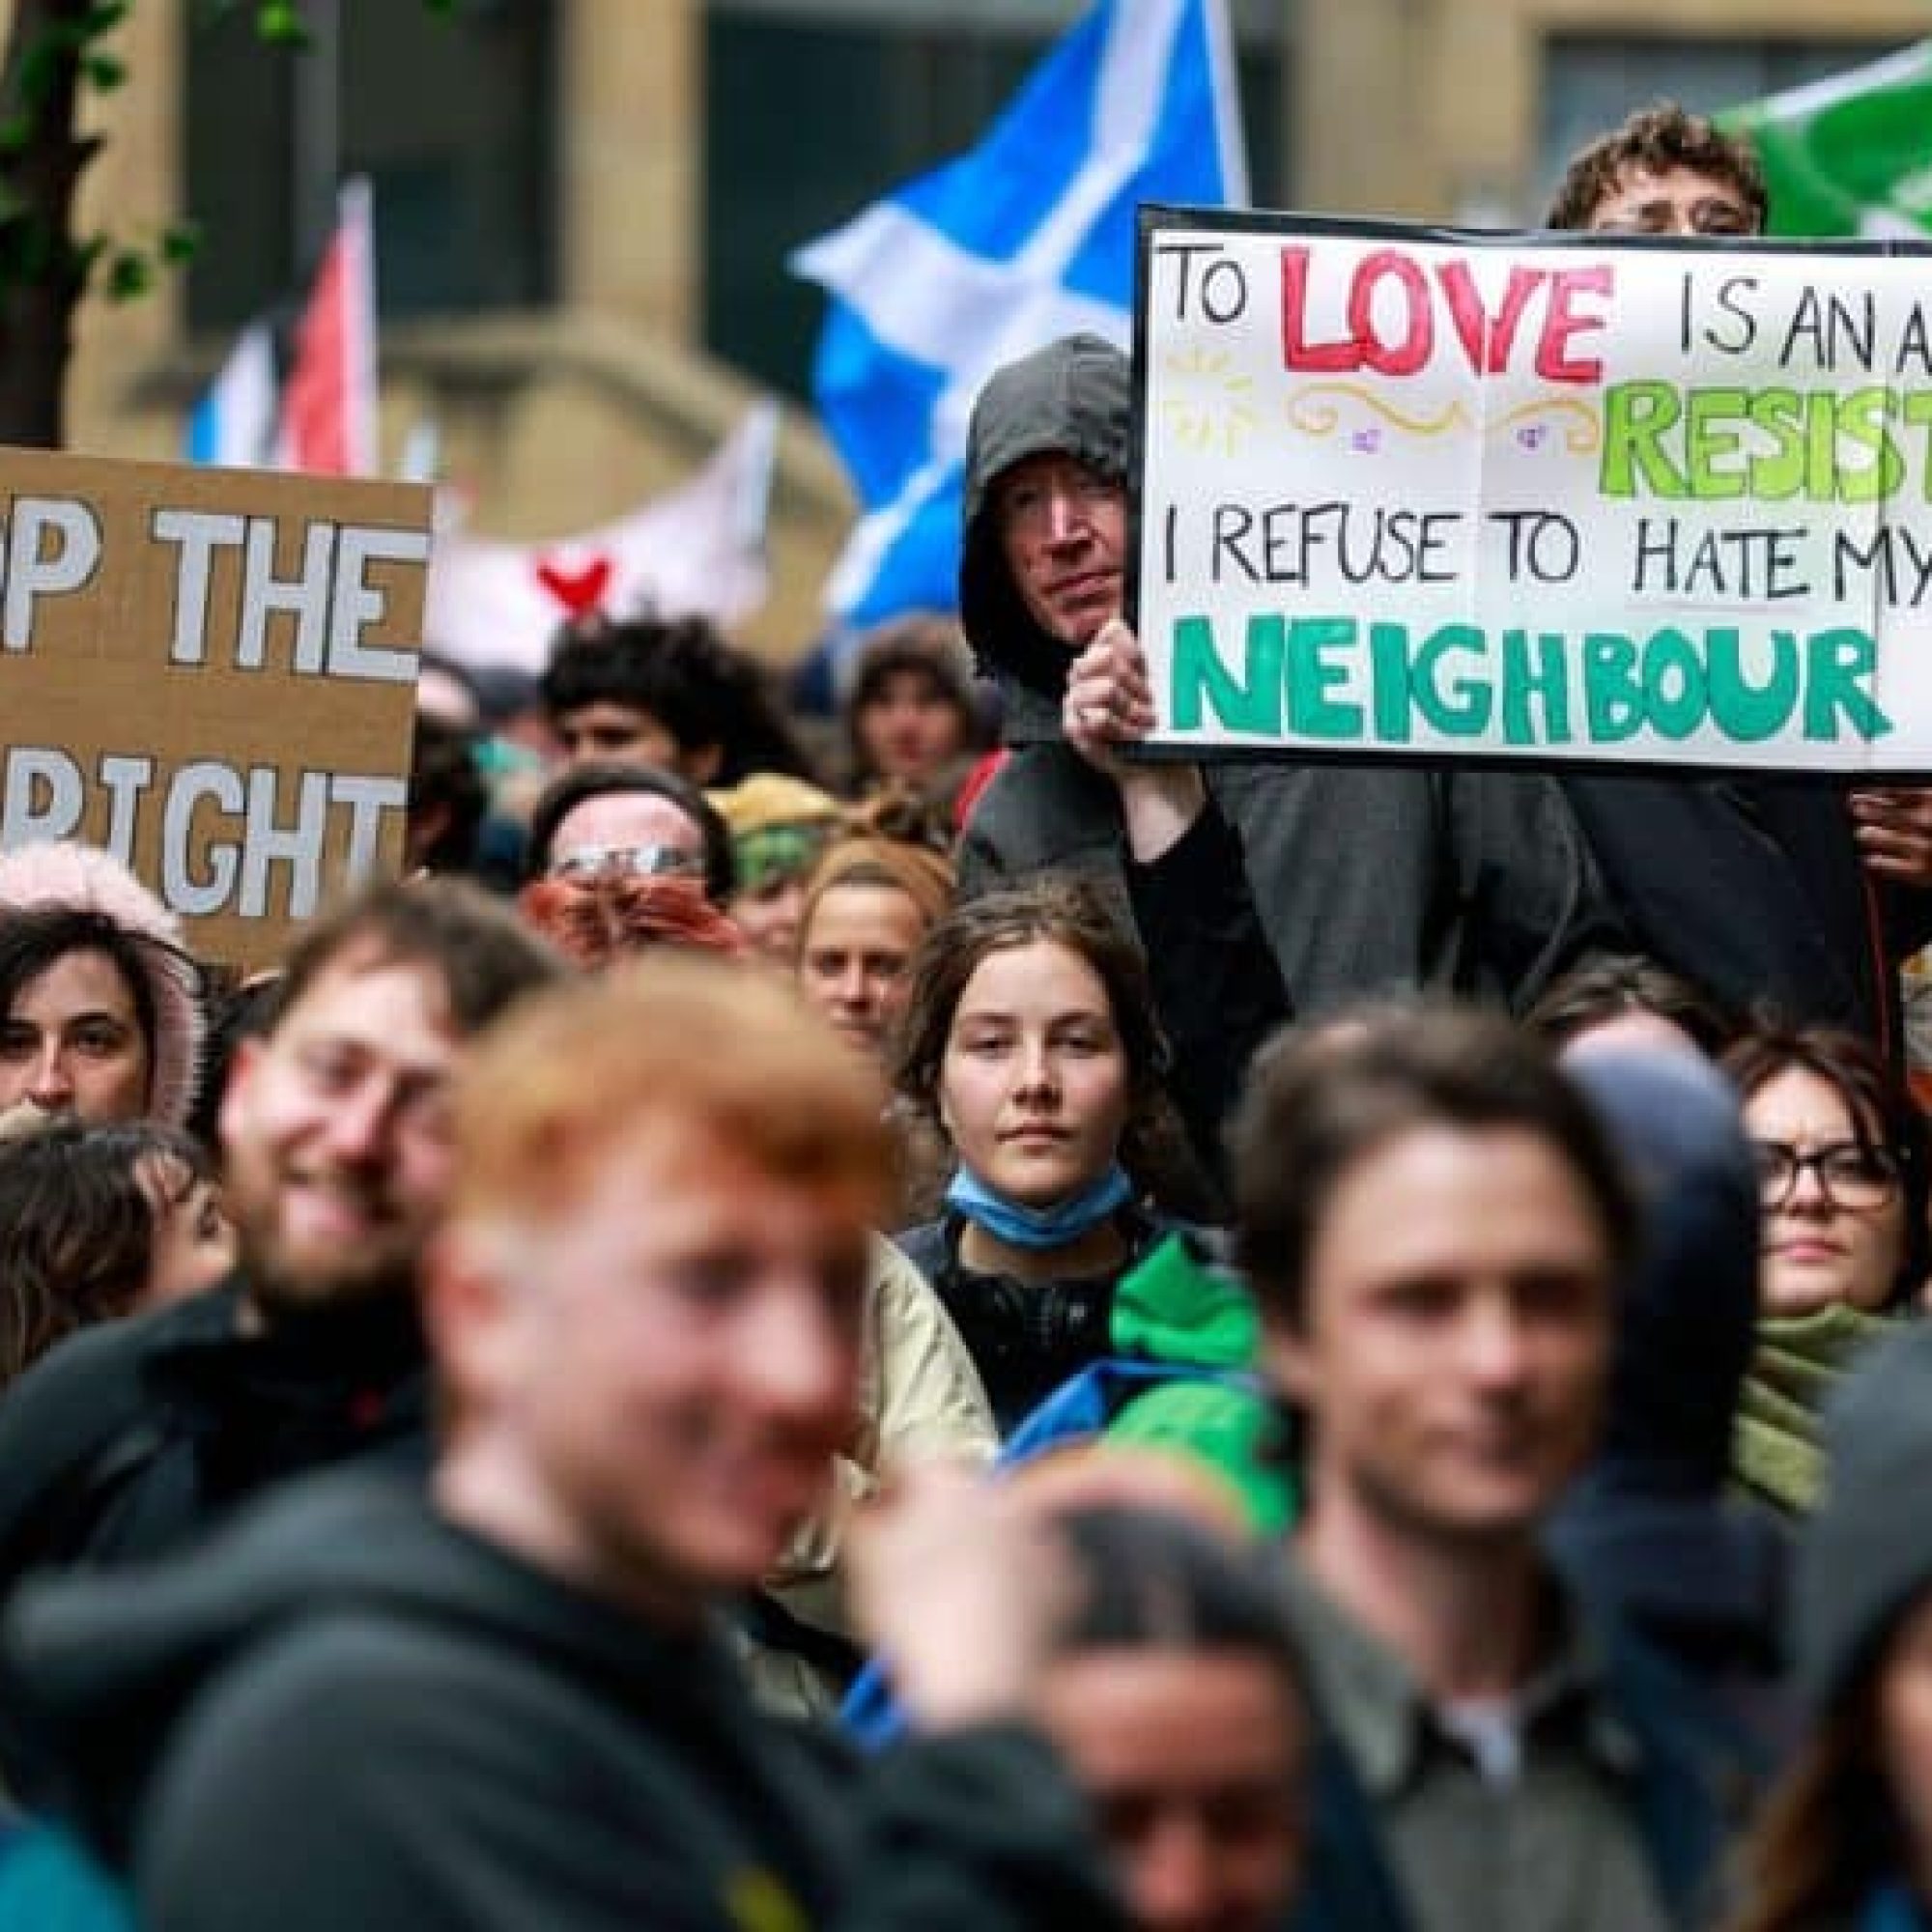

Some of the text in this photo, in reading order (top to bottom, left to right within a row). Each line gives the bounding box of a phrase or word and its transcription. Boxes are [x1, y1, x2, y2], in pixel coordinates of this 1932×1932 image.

[1159, 242, 1248, 325] TO
[1280, 245, 1614, 384] LOVE
[1681, 270, 1759, 355] IS
[1777, 285, 1876, 373] AN
[151, 506, 432, 683] THE
[1164, 503, 1932, 609] I REFUSE TO HATE MY
[1170, 612, 1893, 748] NEIGHBOUR
[0, 744, 409, 918] RIGHT
